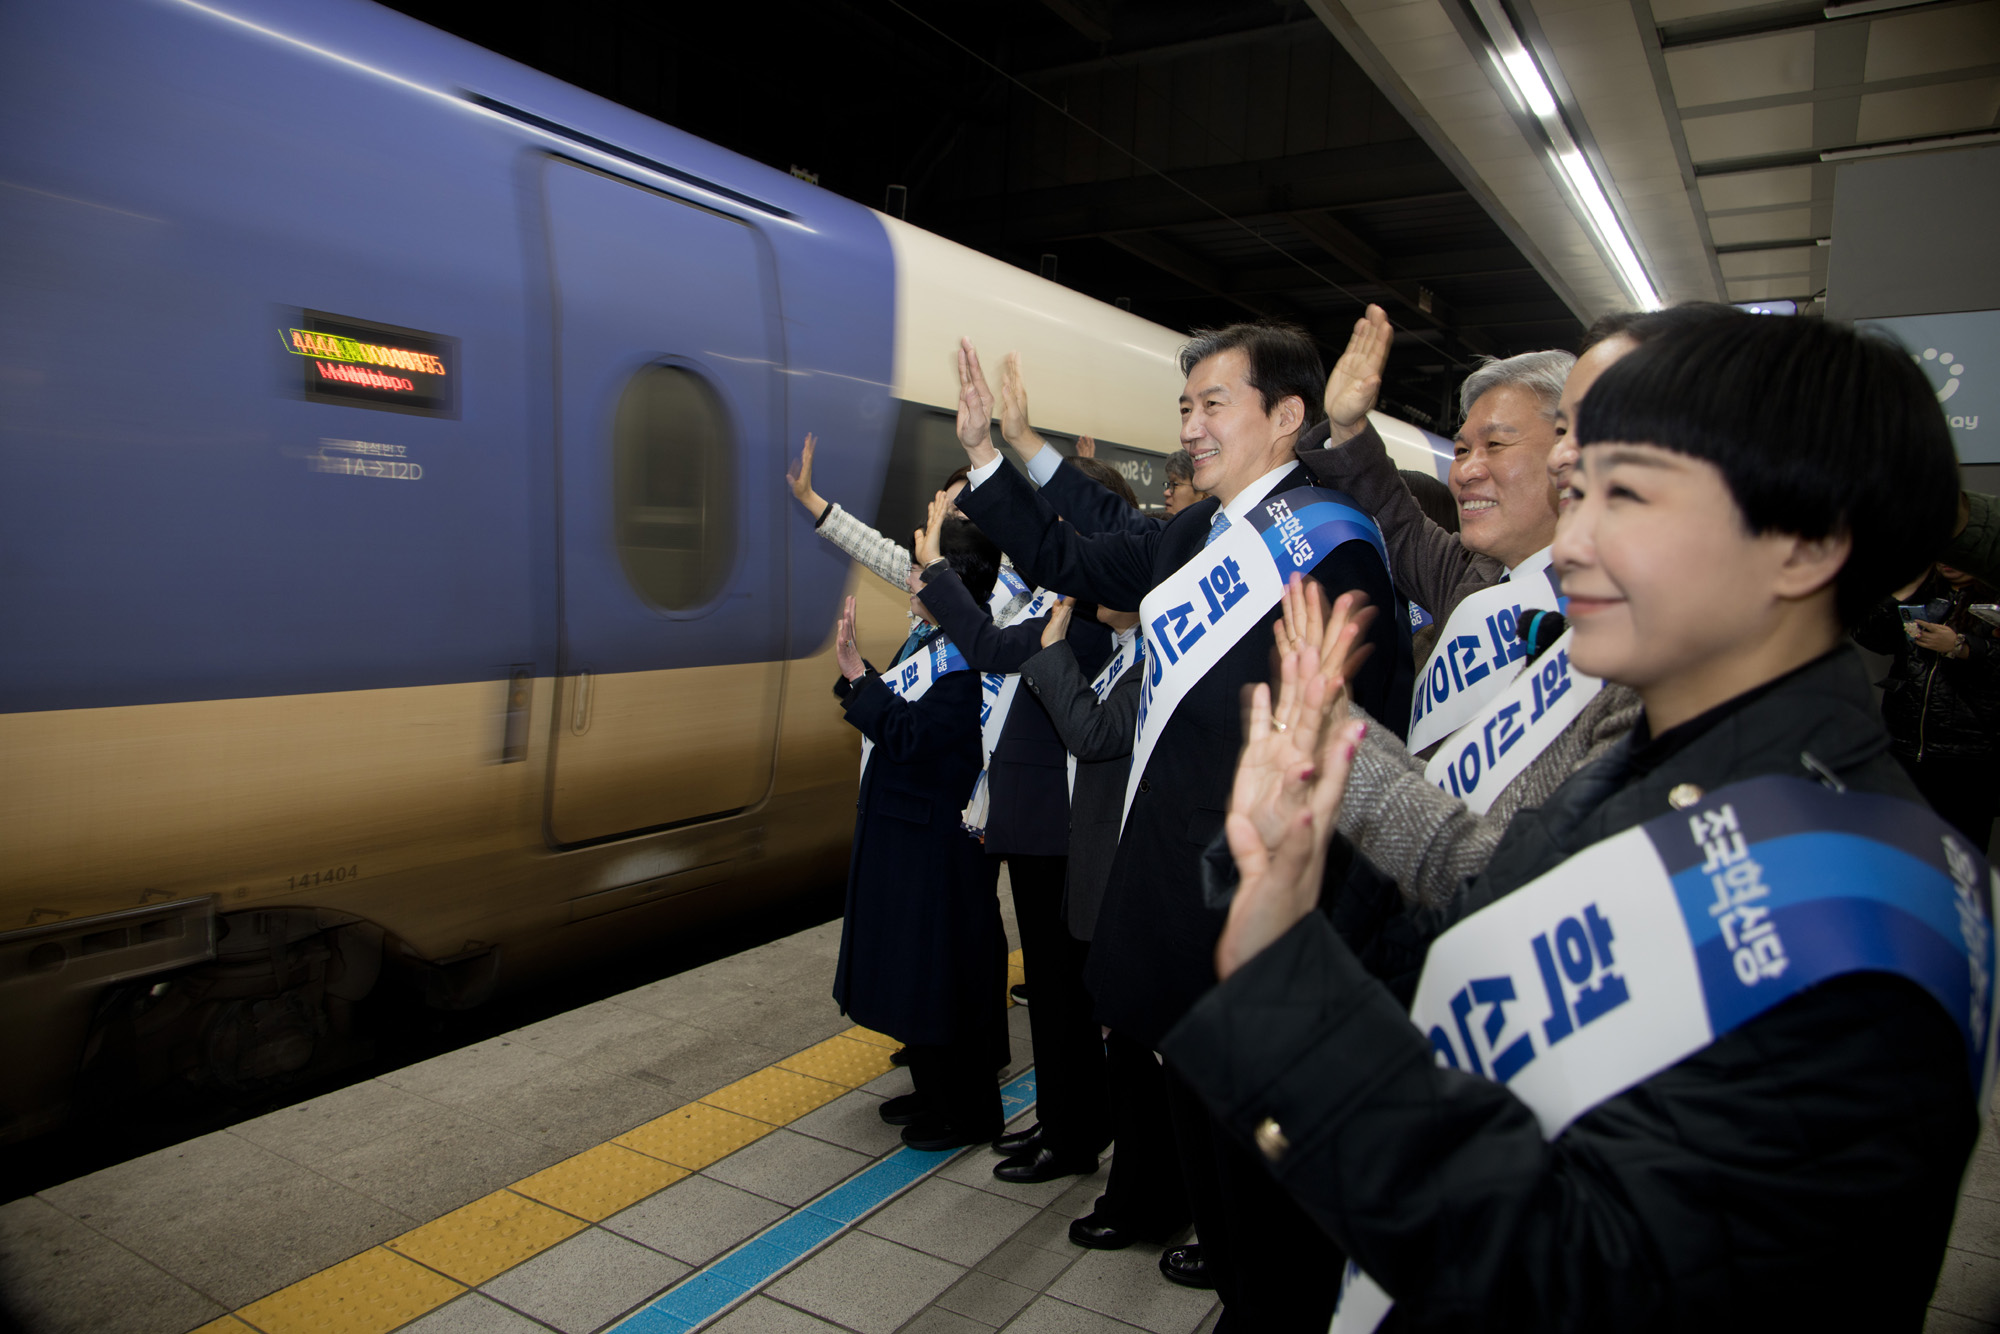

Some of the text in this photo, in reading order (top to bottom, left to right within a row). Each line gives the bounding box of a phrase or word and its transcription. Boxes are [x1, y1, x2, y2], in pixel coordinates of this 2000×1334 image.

[1265, 498, 1315, 567] 조국혁신당
[288, 864, 358, 891] 141404
[1688, 803, 1789, 987] 조국혁신당
